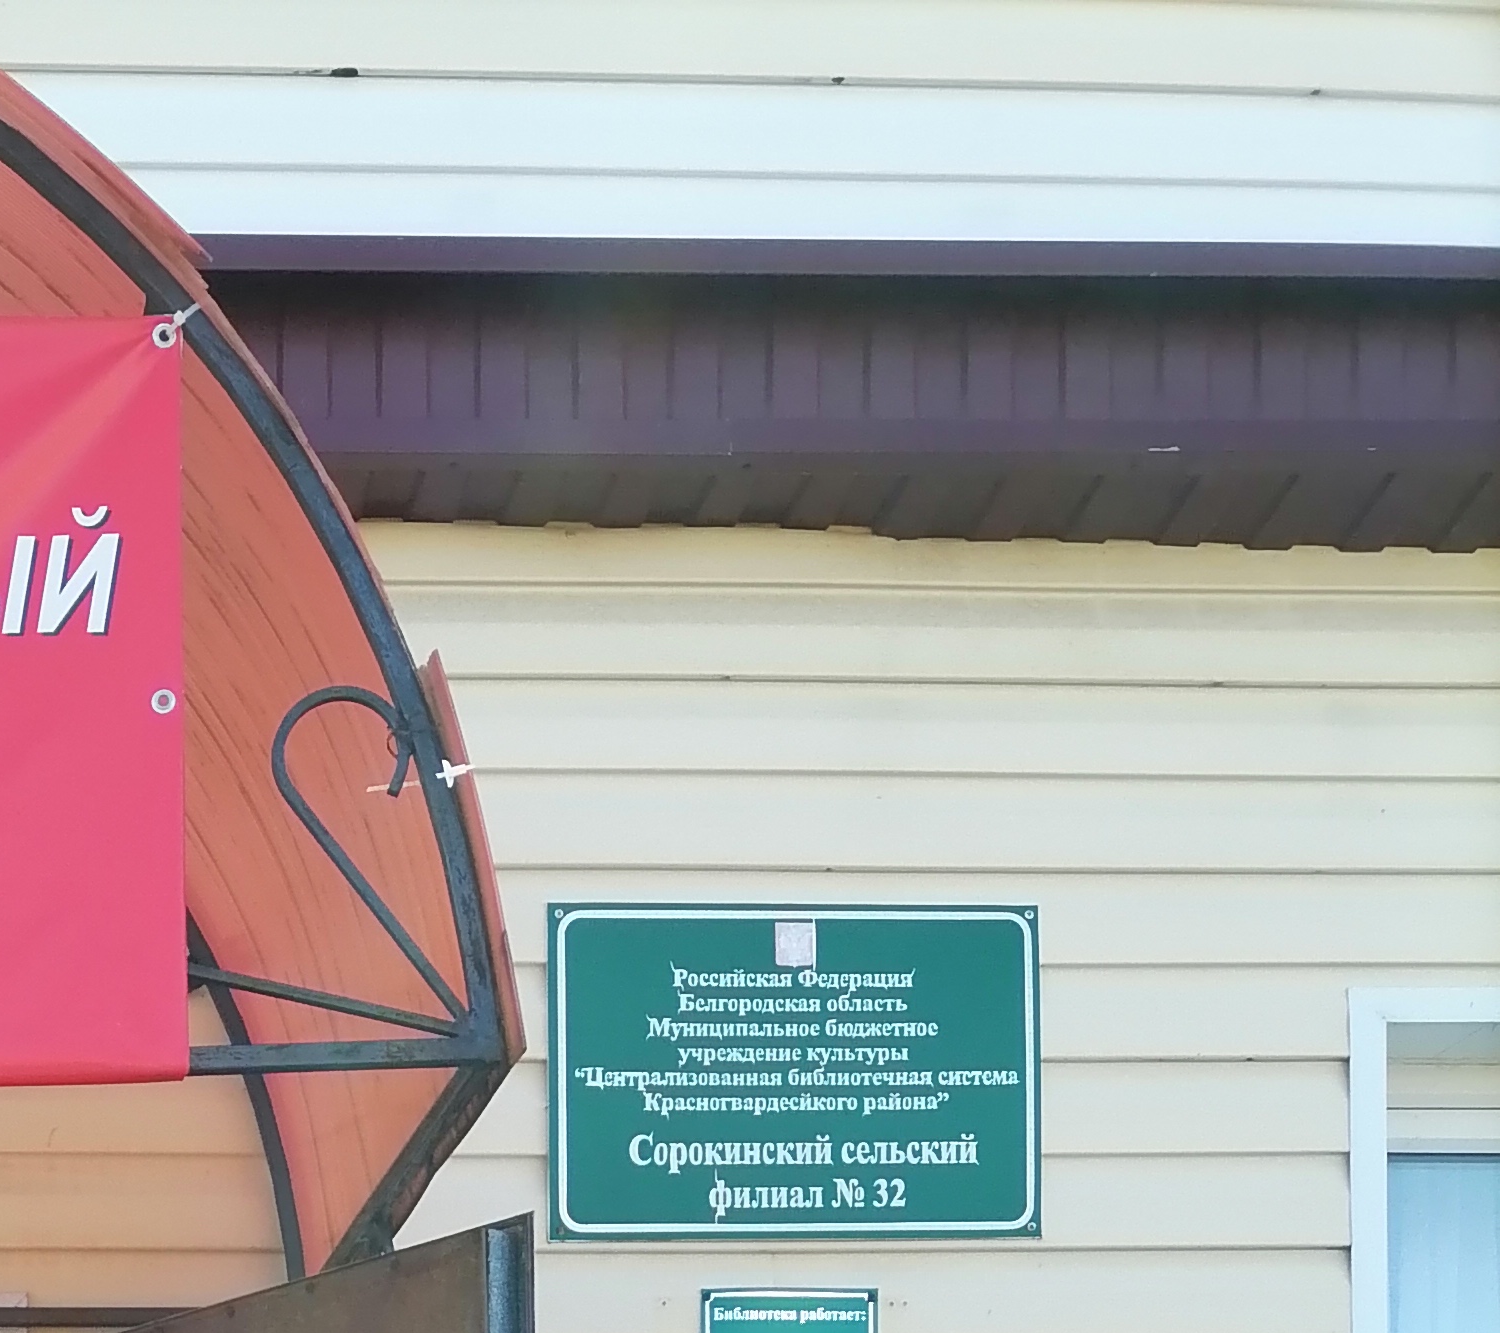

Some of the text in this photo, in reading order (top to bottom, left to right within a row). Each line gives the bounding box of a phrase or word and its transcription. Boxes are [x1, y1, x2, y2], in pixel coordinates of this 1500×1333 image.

[671, 968, 914, 990] Российская Федерация
[678, 992, 908, 1016] Белгородская область
[646, 1017, 938, 1040] Муниципальное бюджетное
[678, 1046, 908, 1067] учреждение культуры
[788, 1068, 933, 1086] библиотечная
[938, 1071, 1018, 1086] система
[863, 1092, 949, 1116] района”
[628, 1132, 978, 1172] Сорокинский сельский
[709, 1178, 906, 1217] филиал № 32
[714, 1307, 867, 1324] Библиотека работает:
